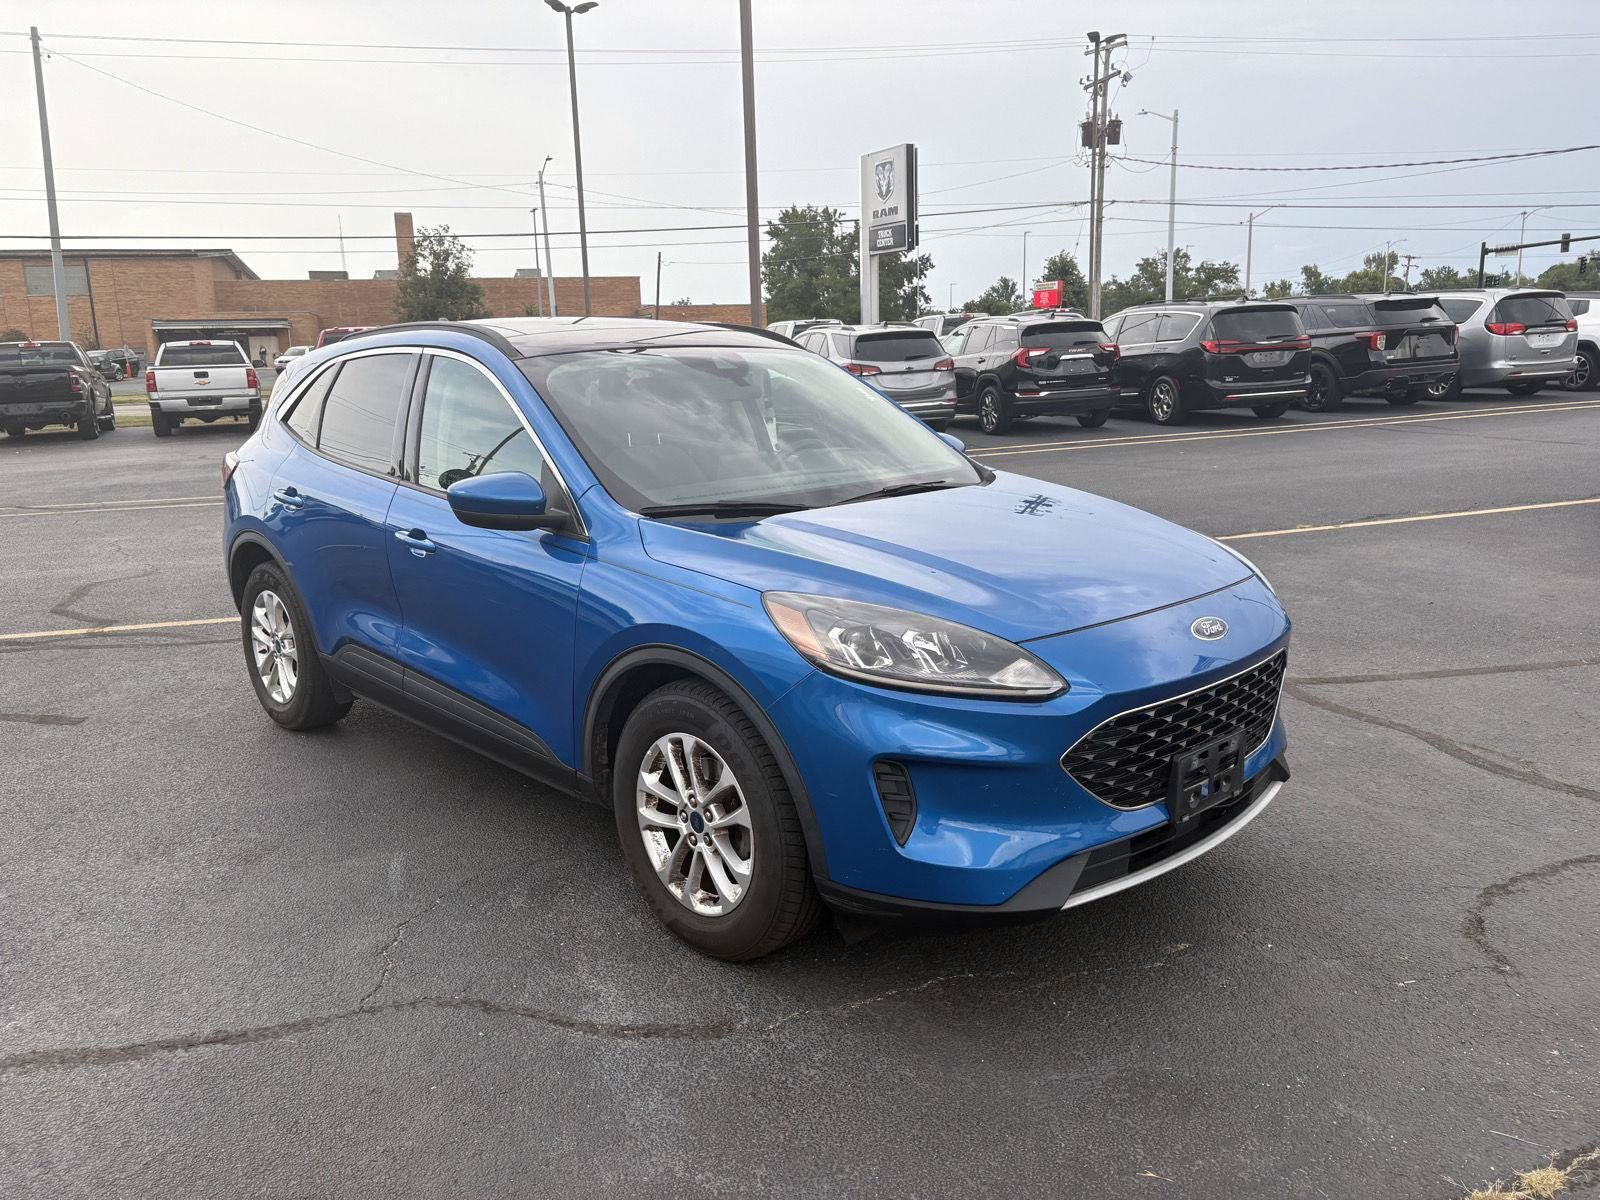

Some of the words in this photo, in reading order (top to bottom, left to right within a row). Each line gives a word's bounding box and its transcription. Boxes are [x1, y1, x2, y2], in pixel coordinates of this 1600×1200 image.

[872, 206, 899, 219] RAM
[877, 228, 893, 238] TRUCK
[876, 238, 894, 247] CENTER
[1200, 620, 1223, 635] Ford
